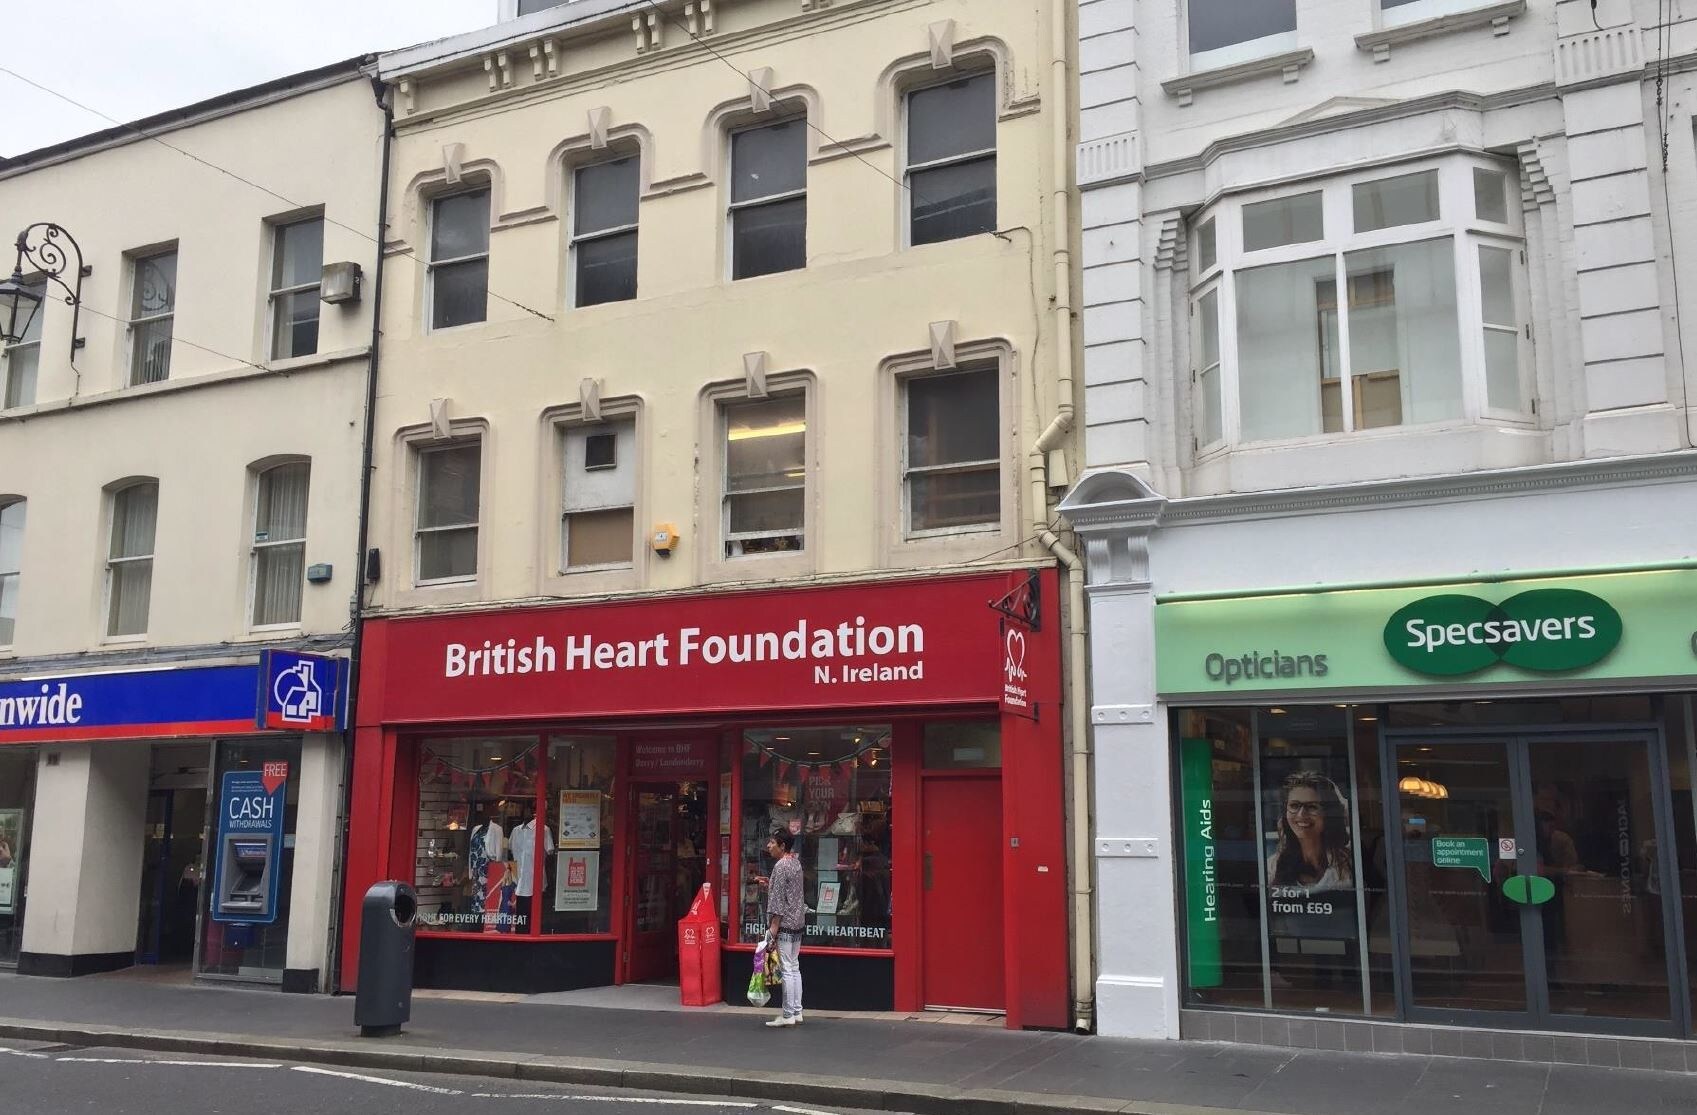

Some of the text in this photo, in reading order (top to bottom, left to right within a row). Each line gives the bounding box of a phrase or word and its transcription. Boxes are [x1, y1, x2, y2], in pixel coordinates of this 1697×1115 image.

[1406, 615, 1596, 653] Specsavers
[445, 616, 924, 678] British Heart Foundation
[814, 661, 924, 684] N. Ireland
[1205, 649, 1329, 685] Opticians
[0, 683, 83, 726] nwide
[264, 763, 287, 777] FREE
[809, 787, 835, 800] YOUR
[229, 797, 274, 819] CASH
[229, 819, 272, 829] WITHDRAWALS
[1436, 840, 1455, 848] Book
[1436, 848, 1484, 857] appointment
[1199, 799, 1217, 922] Hearing Aids
[1271, 886, 1280, 898] 2
[1282, 886, 1302, 899] for
[1304, 888, 1311, 899] 1
[1272, 900, 1333, 915] from £69
[440, 913, 454, 923] FOR
[455, 913, 480, 924] EVERY
[481, 914, 527, 926] HEARTBEAT
[745, 923, 886, 938] FIGH ERY HEARTBEAT
